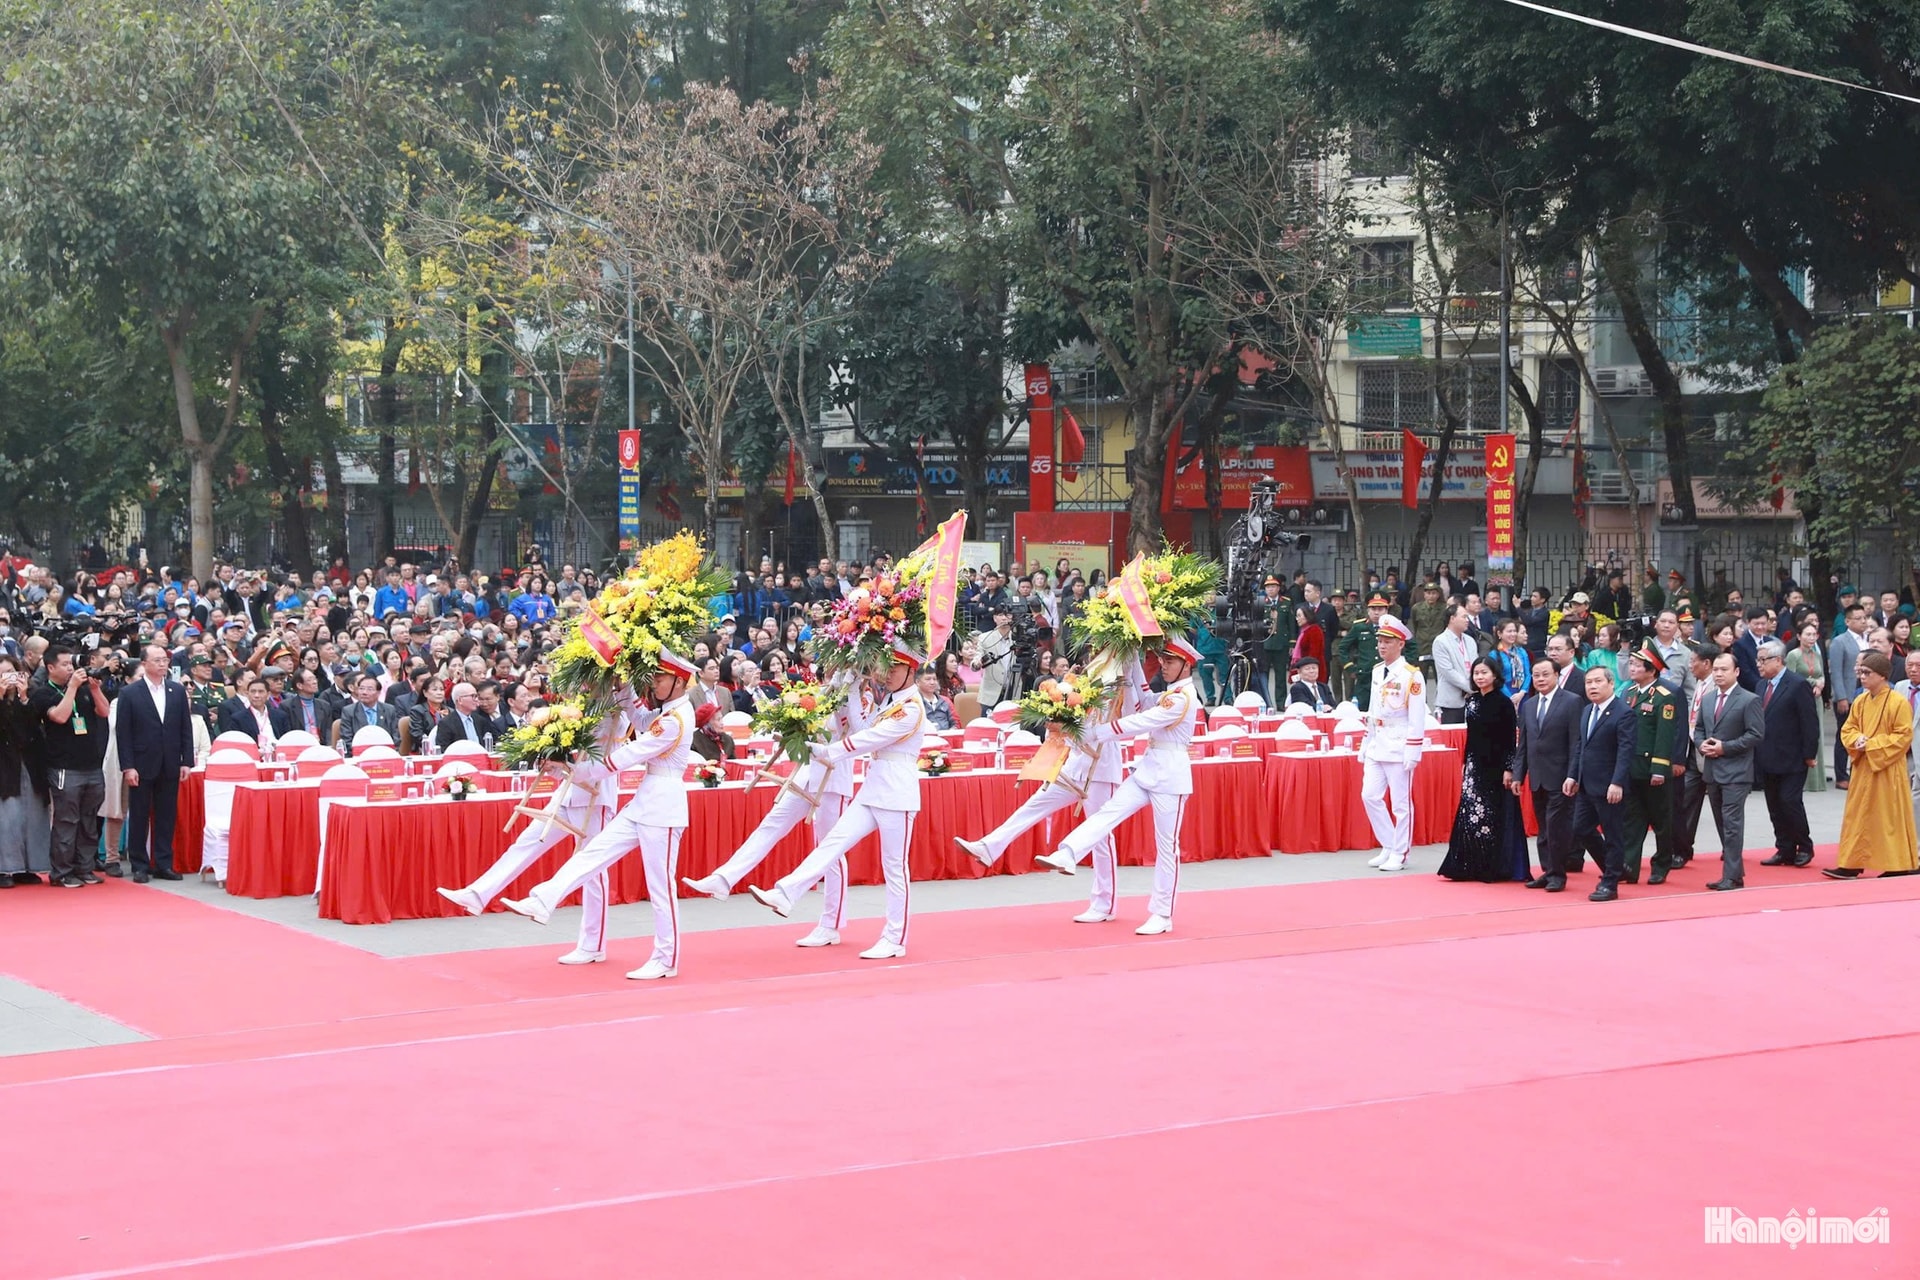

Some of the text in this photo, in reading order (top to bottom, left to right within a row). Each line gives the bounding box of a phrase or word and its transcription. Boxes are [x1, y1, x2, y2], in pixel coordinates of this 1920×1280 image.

[1029, 382, 1048, 395] 5G
[1031, 460, 1051, 473] 5G
[1335, 466, 1373, 478] TUNG
